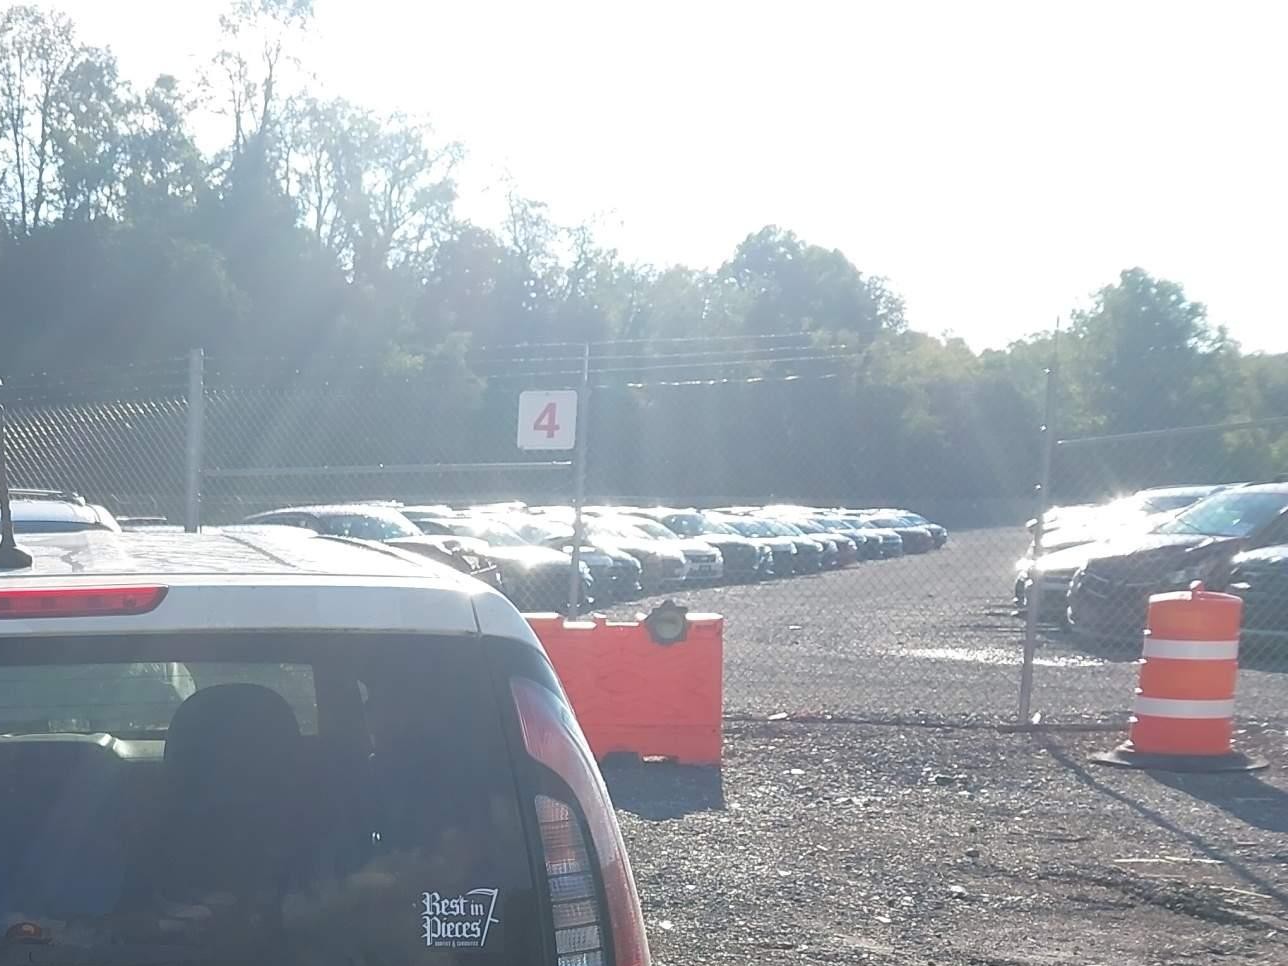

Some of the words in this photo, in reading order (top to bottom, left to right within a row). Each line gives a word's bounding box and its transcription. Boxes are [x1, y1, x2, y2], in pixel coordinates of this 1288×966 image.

[533, 402, 560, 439] 4
[421, 891, 468, 917] Rest
[470, 899, 485, 916] in
[421, 915, 482, 946] Pieces
